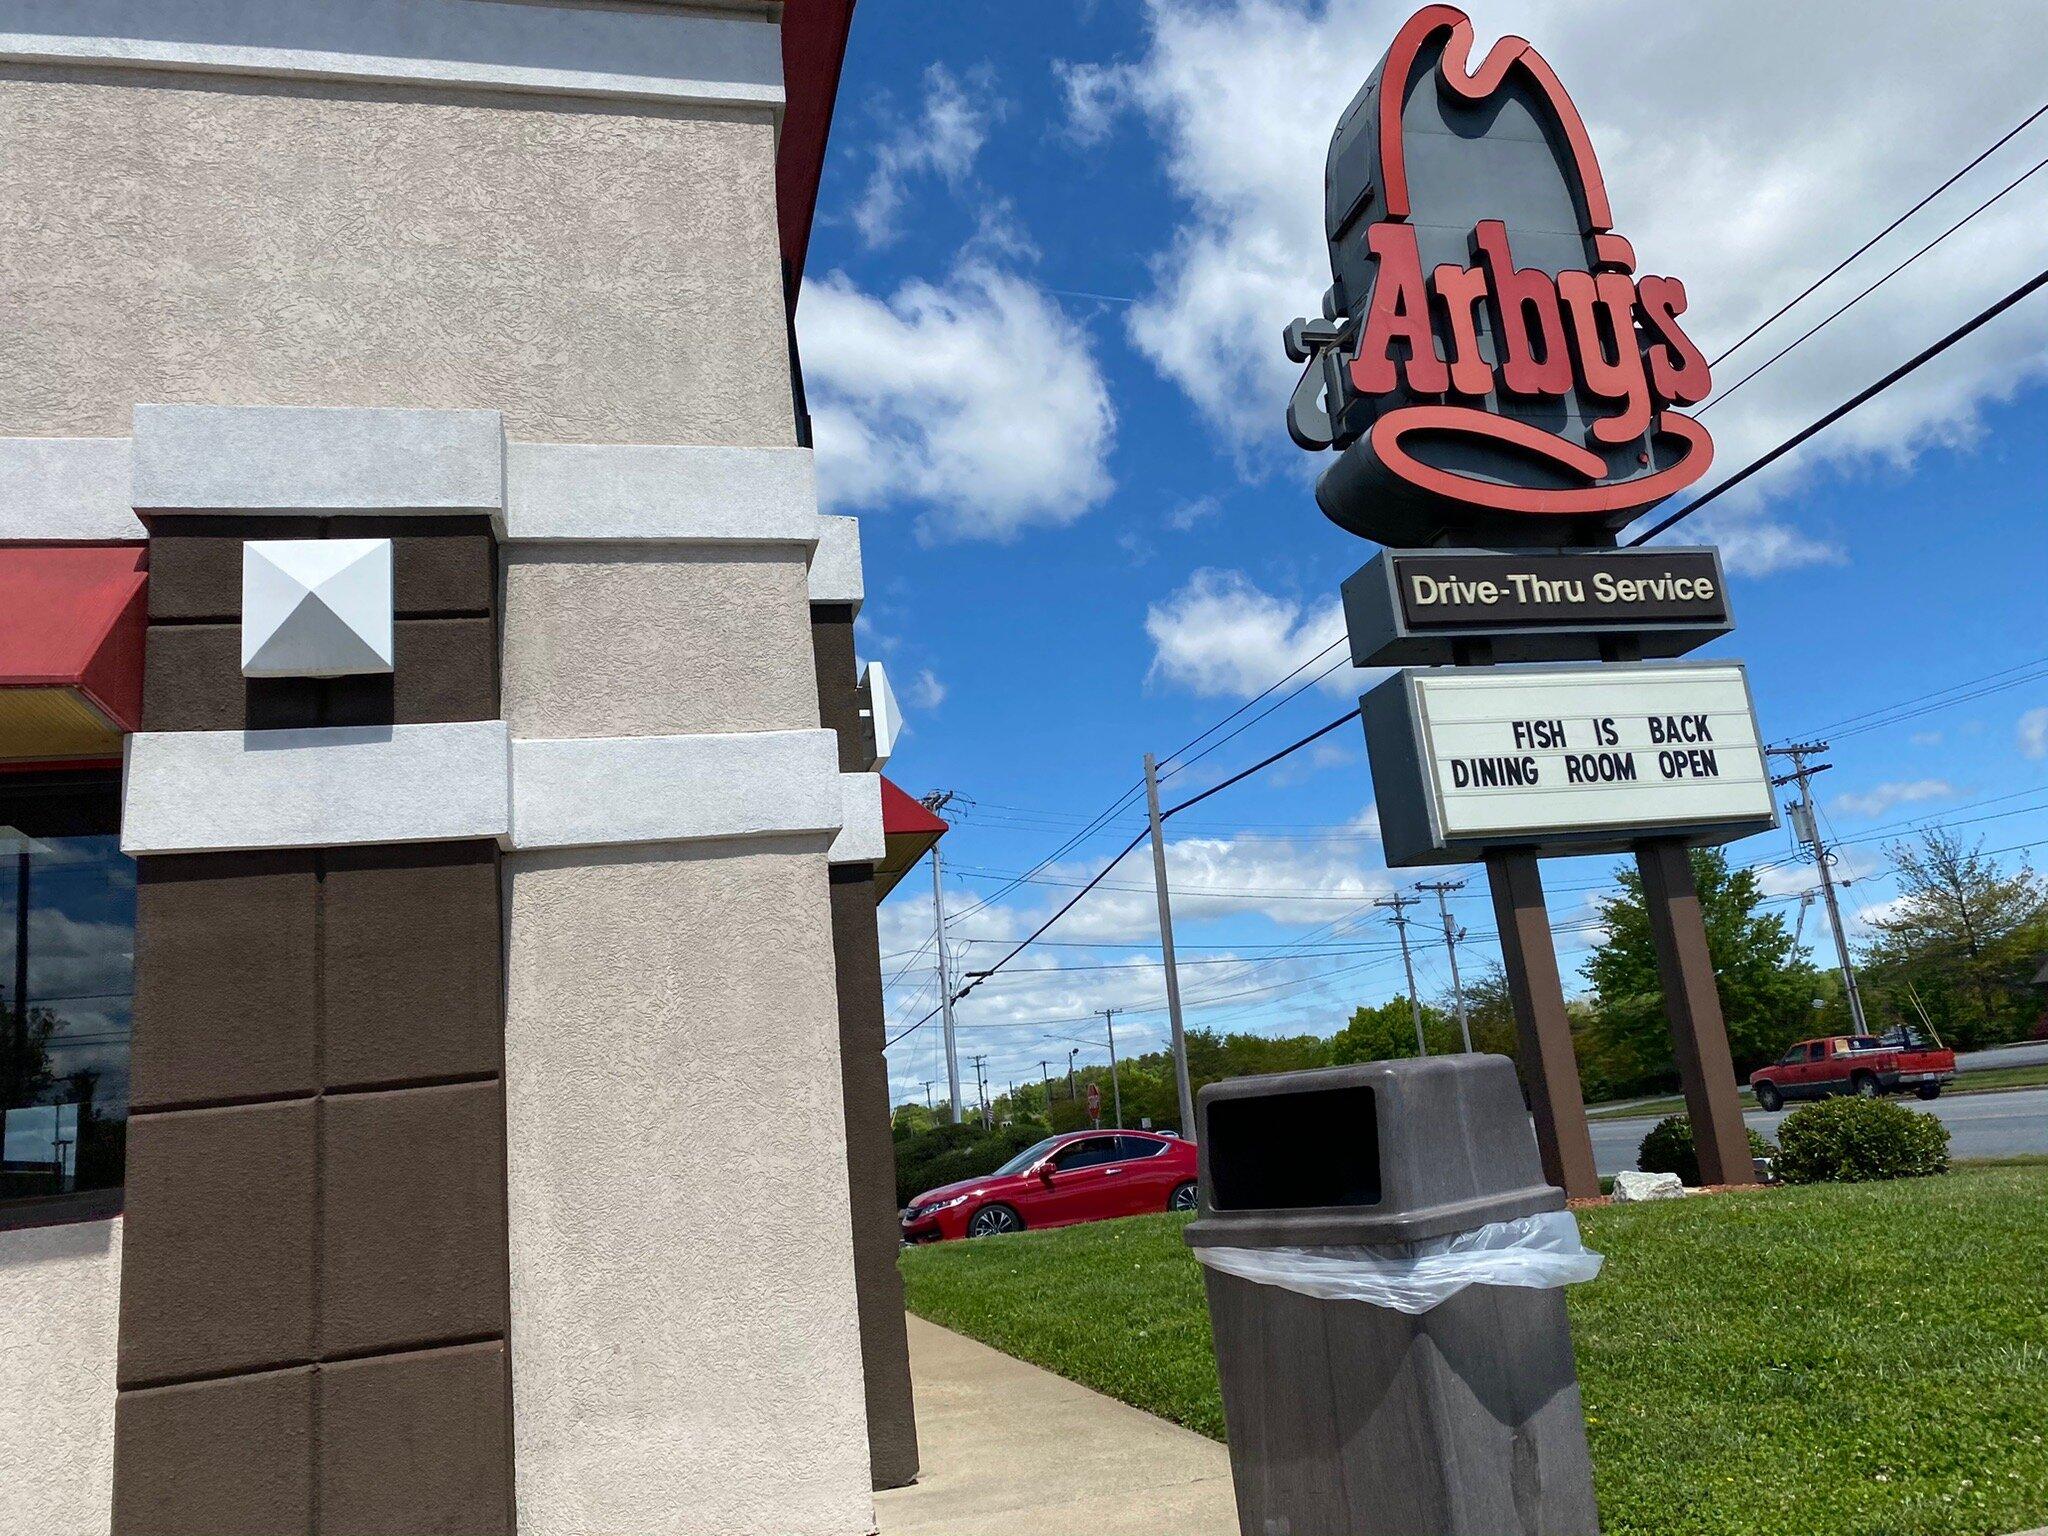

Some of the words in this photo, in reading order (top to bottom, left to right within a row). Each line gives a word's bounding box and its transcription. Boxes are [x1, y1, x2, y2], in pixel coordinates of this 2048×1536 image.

[1350, 220, 1712, 443] Arby's
[1411, 574, 1586, 605] Drive-Thru
[1593, 572, 1715, 603] Service
[1512, 720, 1567, 749] FISH
[1594, 718, 1619, 746] IS
[1649, 714, 1713, 744] BACK
[1451, 756, 1539, 788] DINING
[1567, 752, 1638, 783] ROOM
[1659, 749, 1719, 778] OPEN
